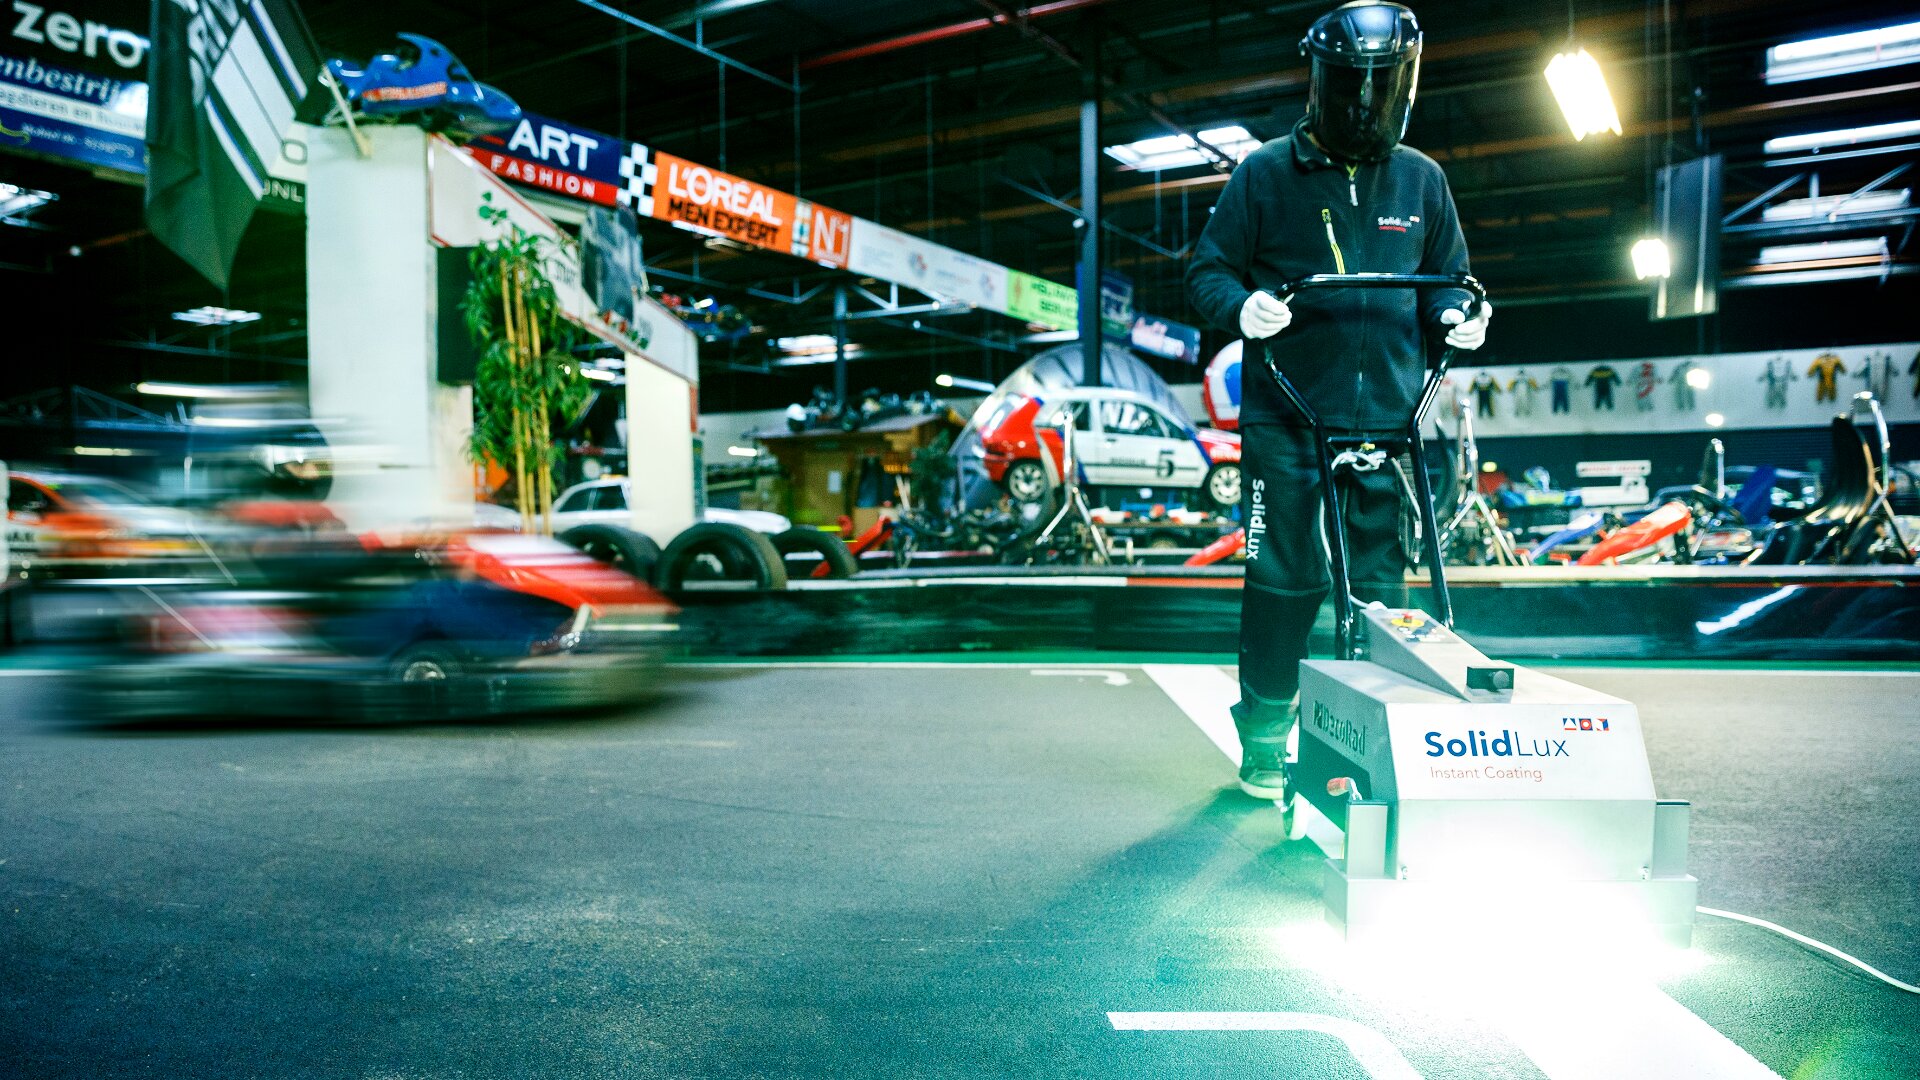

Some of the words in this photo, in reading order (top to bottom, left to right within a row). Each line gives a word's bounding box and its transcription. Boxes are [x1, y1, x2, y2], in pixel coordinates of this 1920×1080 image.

[12, 1, 143, 68] zero
[508, 118, 599, 171] ART
[490, 154, 596, 198] FASHION
[668, 162, 783, 226] L'ORÉAL
[668, 198, 710, 225] MEN
[714, 209, 779, 244] EXPERT
[1157, 450, 1175, 478] 5
[1246, 478, 1266, 560] SolidLux
[1424, 729, 1570, 757] SolidLux
[1430, 766, 1481, 780] Instant
[1484, 765, 1543, 783] Coating
